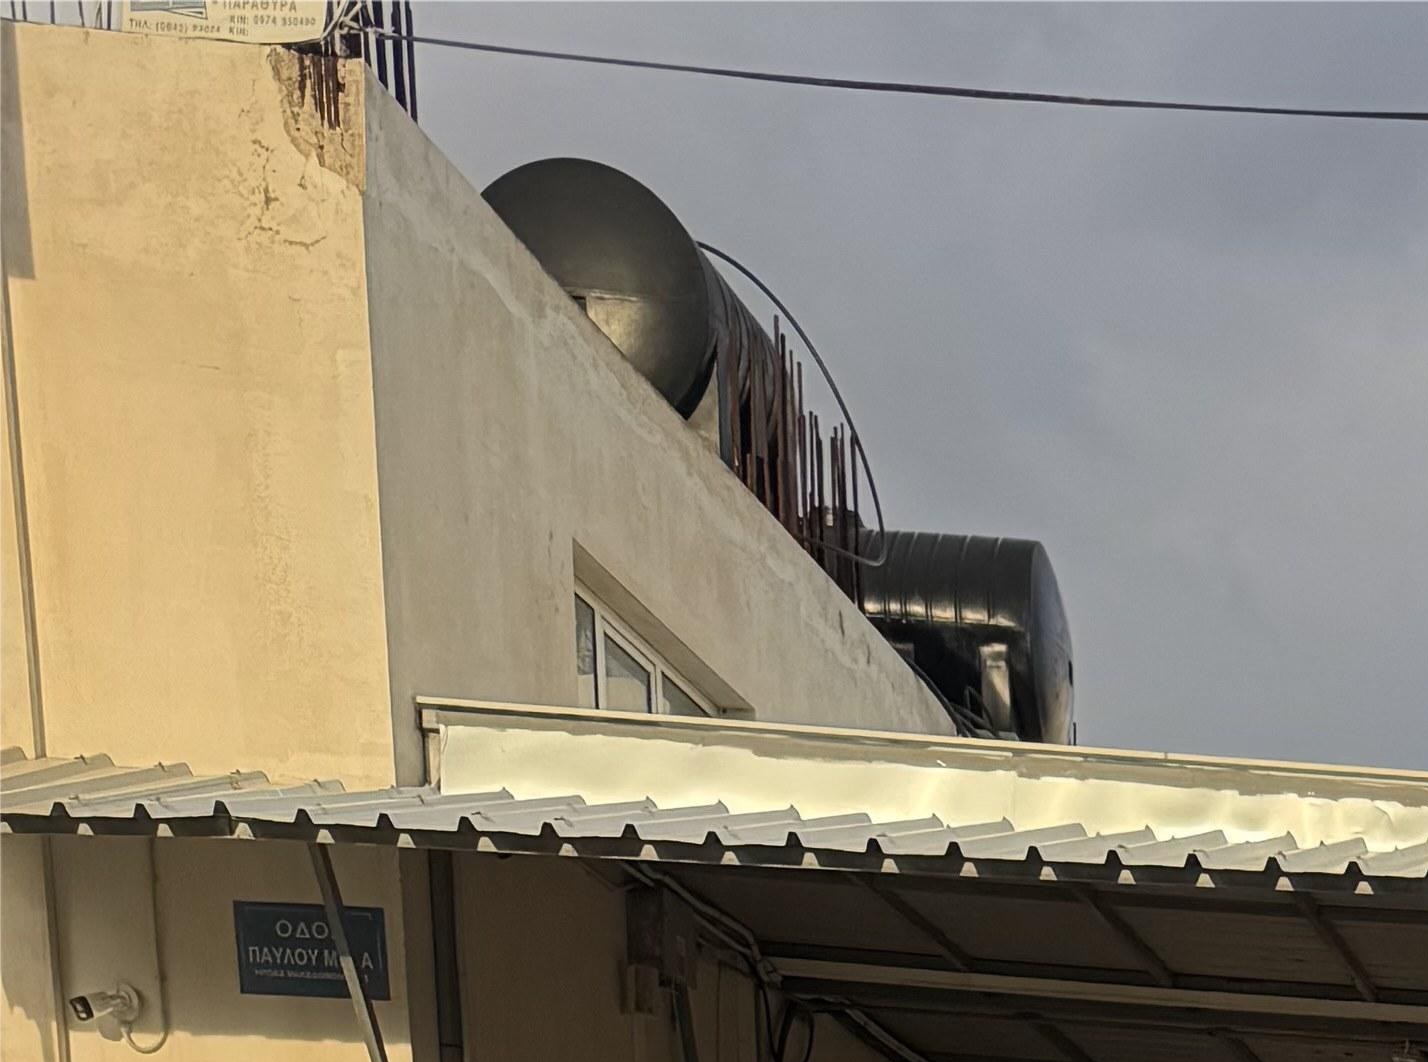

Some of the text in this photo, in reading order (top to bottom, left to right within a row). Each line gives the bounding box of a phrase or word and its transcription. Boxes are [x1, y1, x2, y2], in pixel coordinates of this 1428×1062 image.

[275, 919, 331, 940] ΟΔΟ
[248, 946, 374, 971] ΠΑΥΛΟΥ ΜΑ
